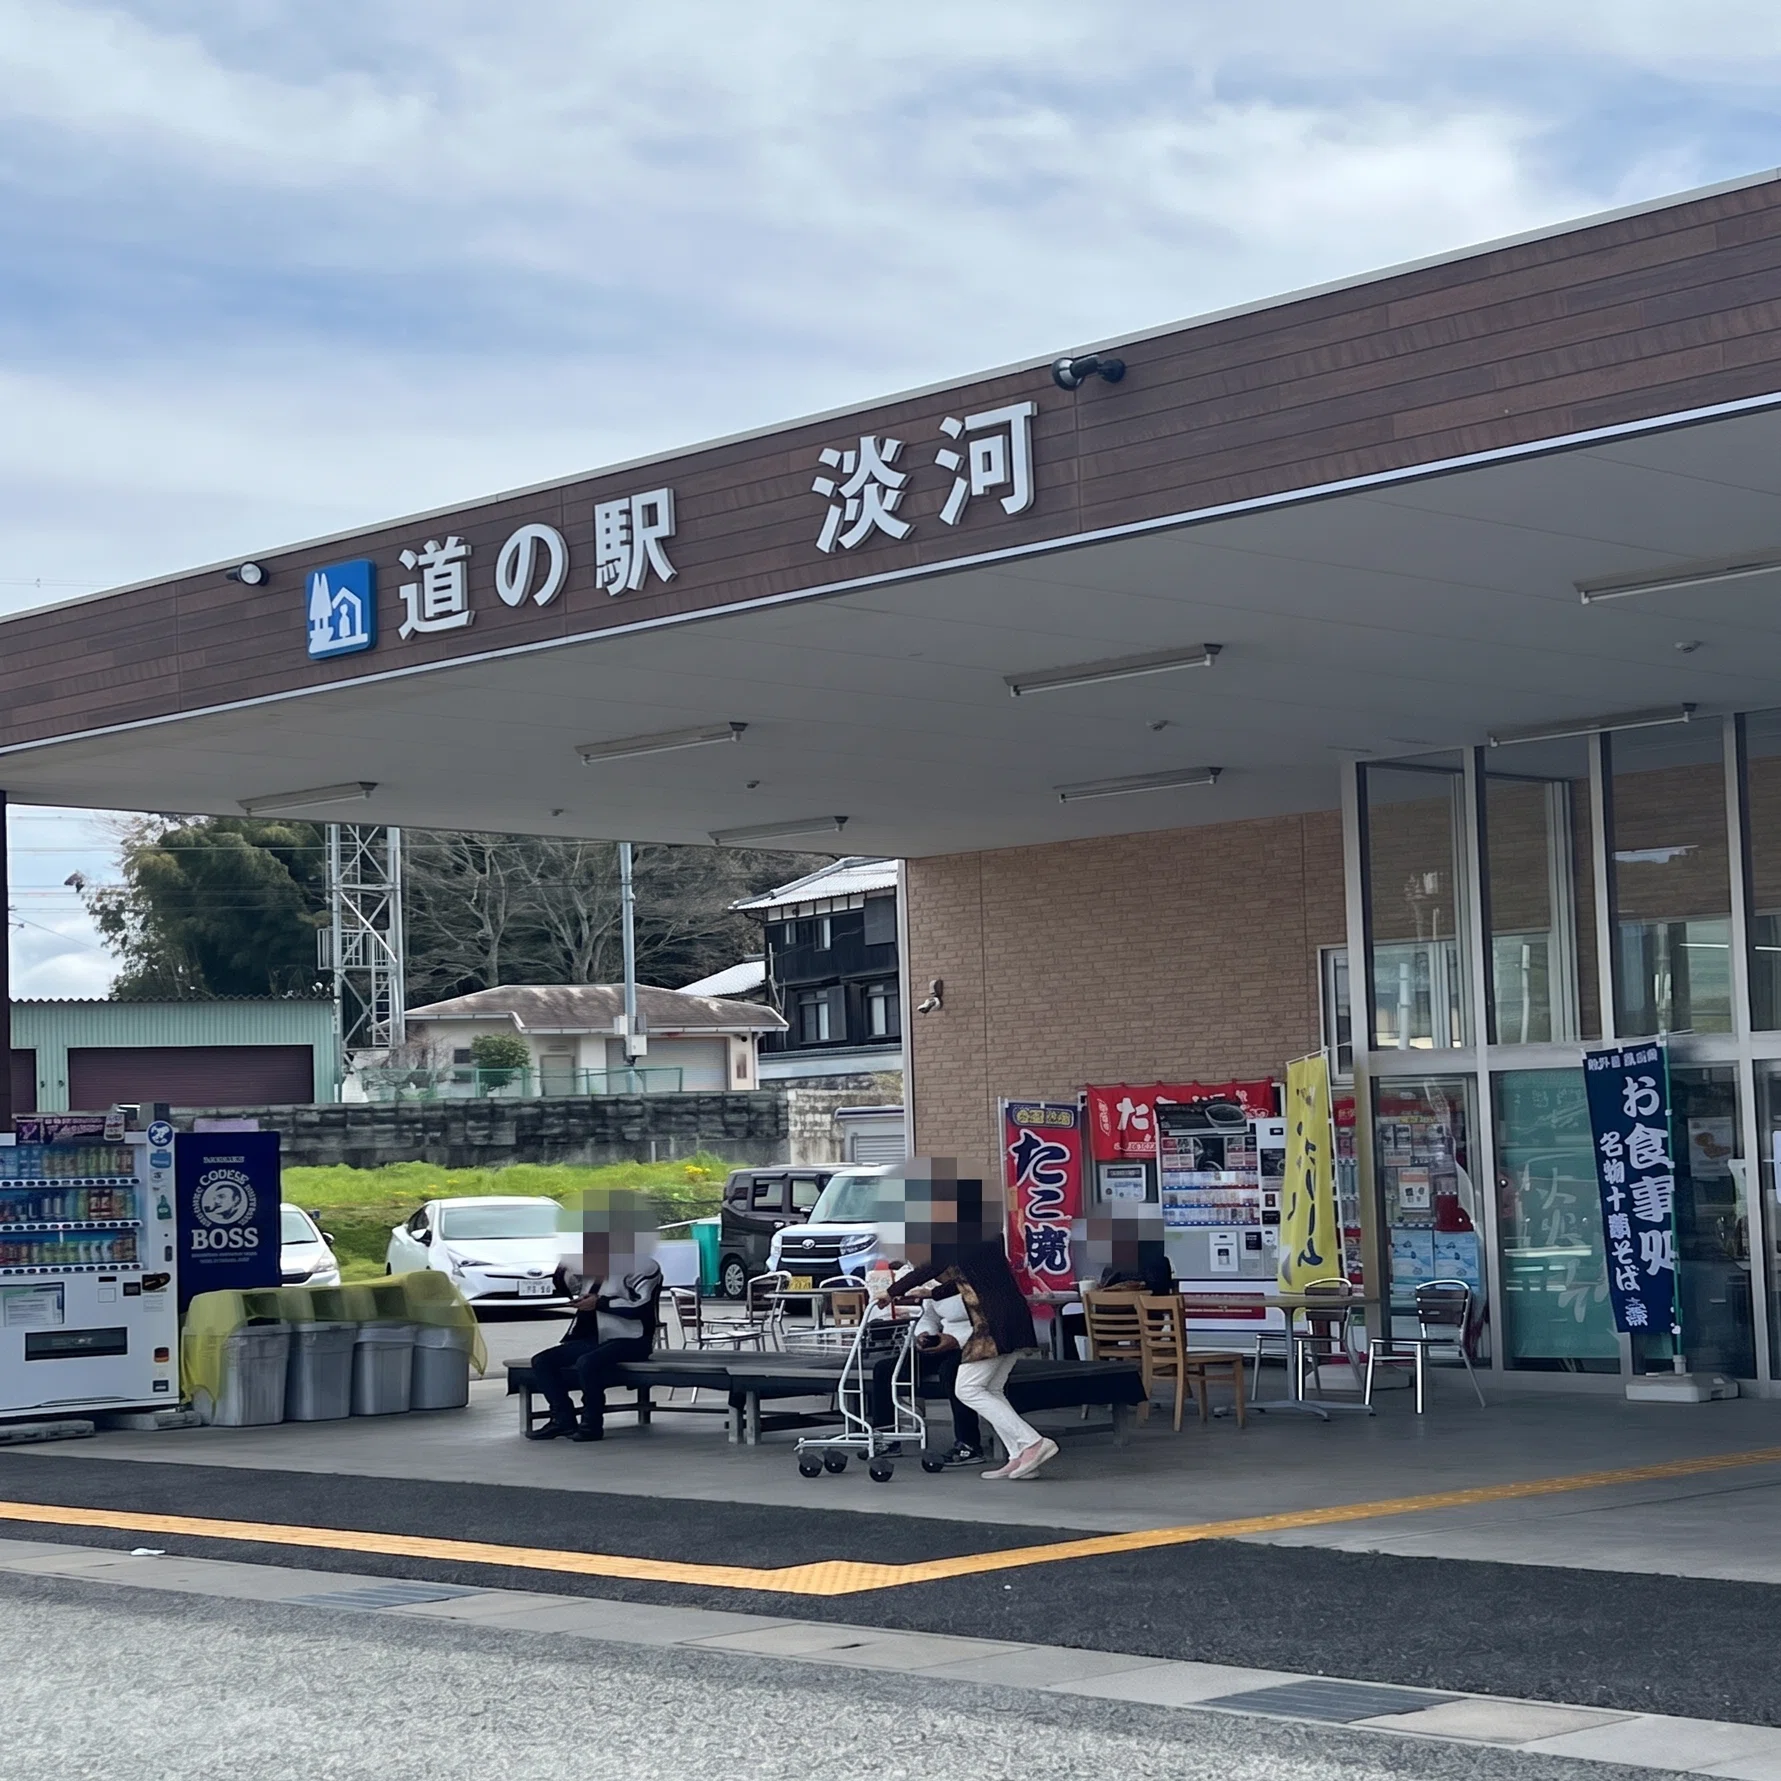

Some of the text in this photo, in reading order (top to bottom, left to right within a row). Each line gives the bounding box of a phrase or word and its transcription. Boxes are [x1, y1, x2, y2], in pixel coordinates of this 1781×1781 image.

[396, 400, 1039, 640] 道の駅 淡河
[190, 1226, 259, 1250] BOSS
[1622, 1076, 1675, 1275] お食事処
